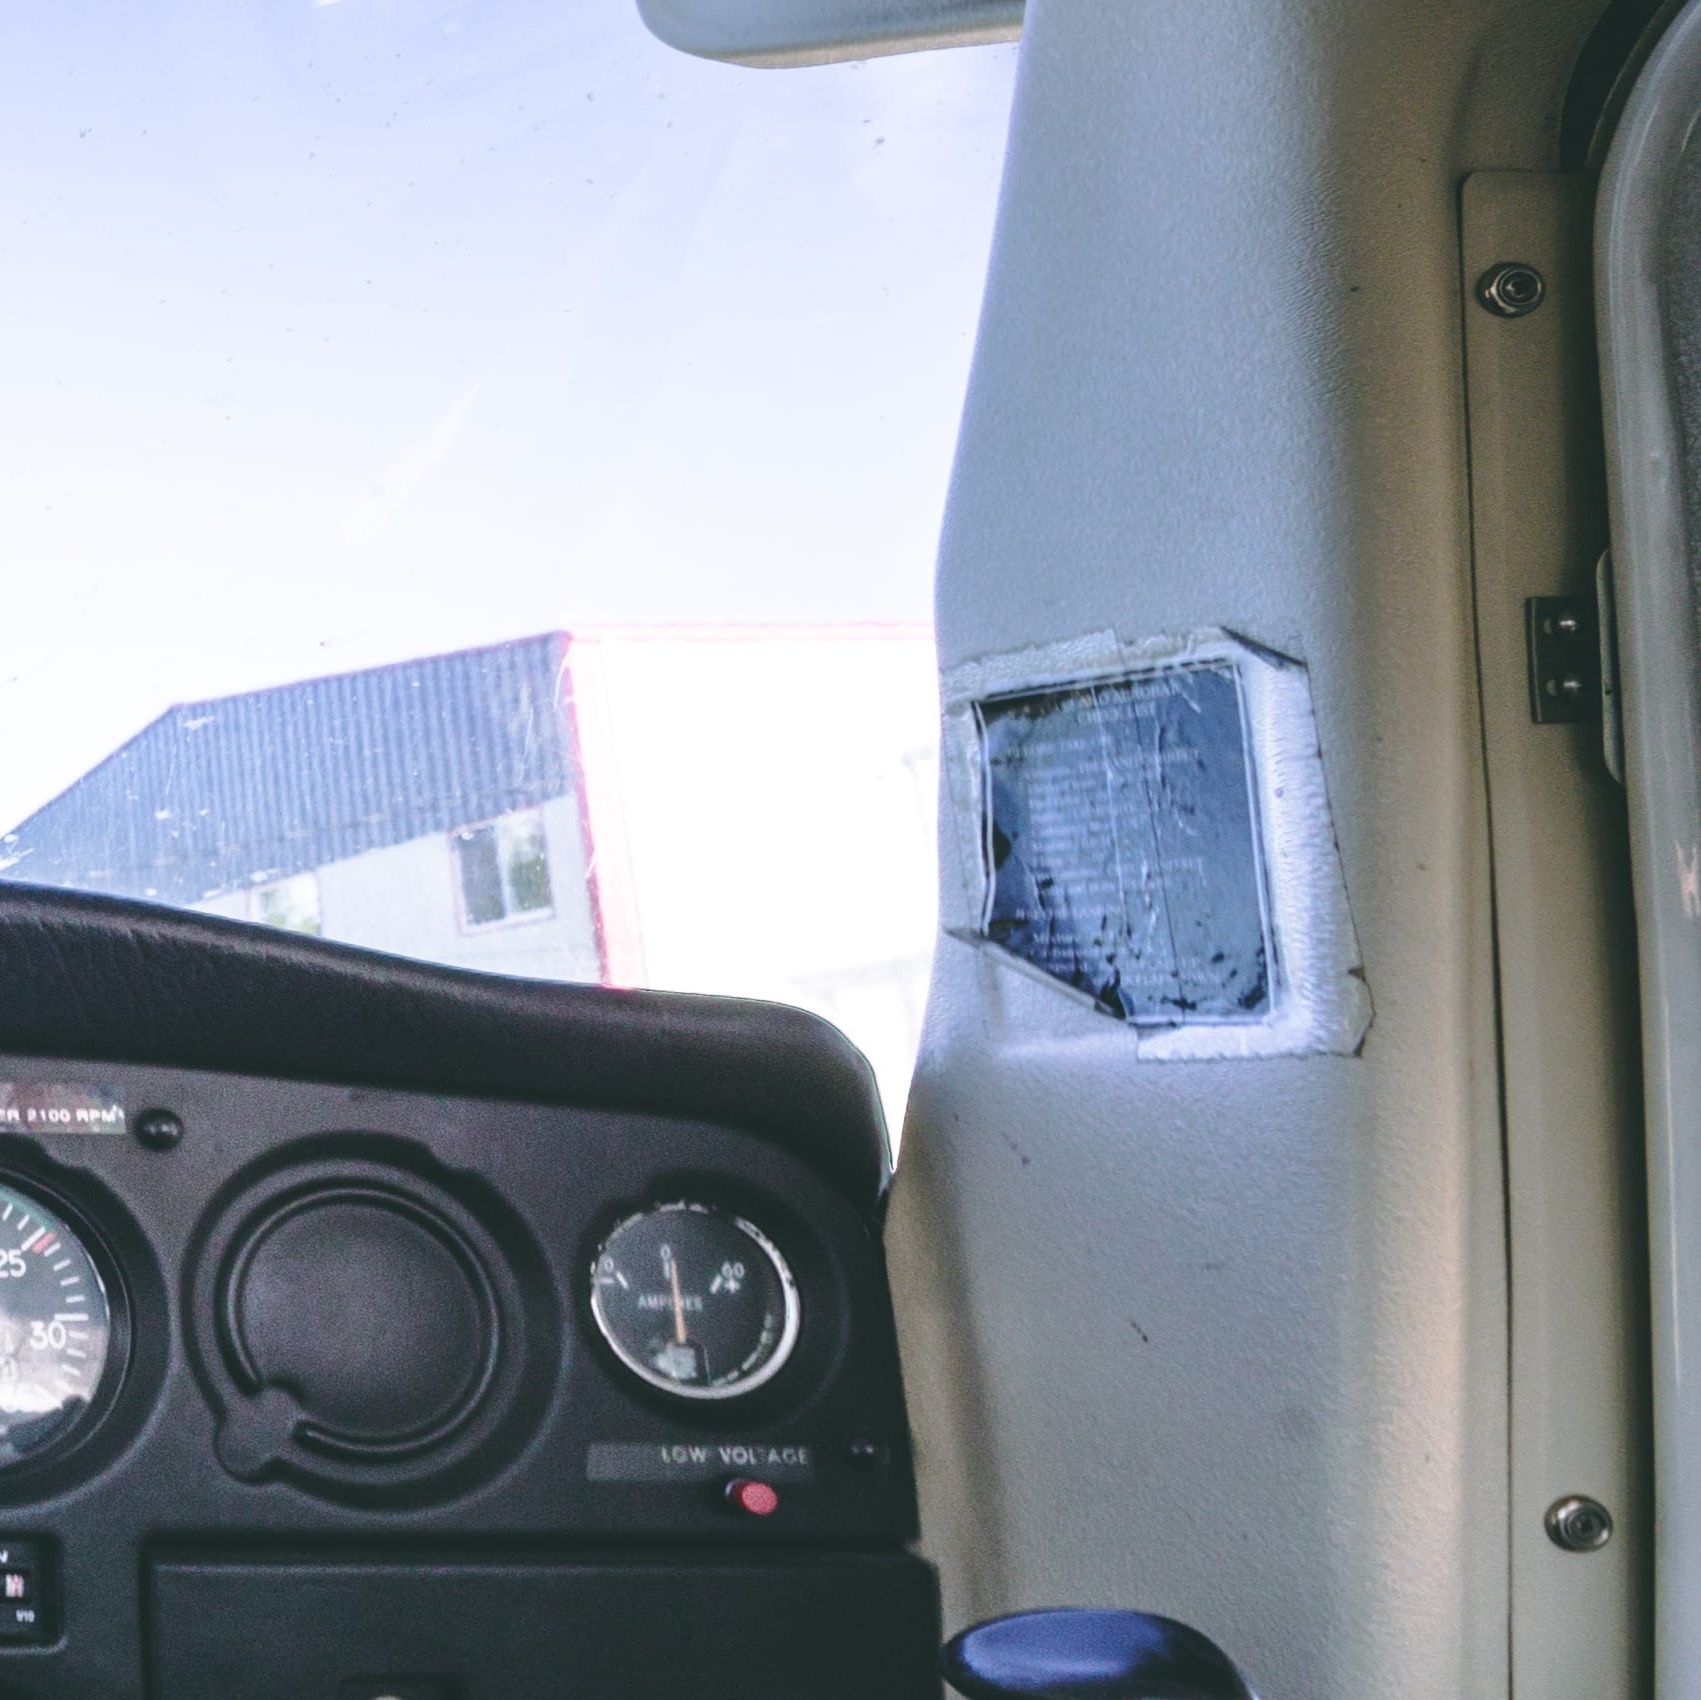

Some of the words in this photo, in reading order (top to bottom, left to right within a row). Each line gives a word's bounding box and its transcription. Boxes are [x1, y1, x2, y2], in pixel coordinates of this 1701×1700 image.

[27, 1107, 71, 1122] 2100
[30, 1321, 67, 1349] 30
[661, 1446, 707, 1464] LOW
[719, 1446, 809, 1466] VOLAGE
